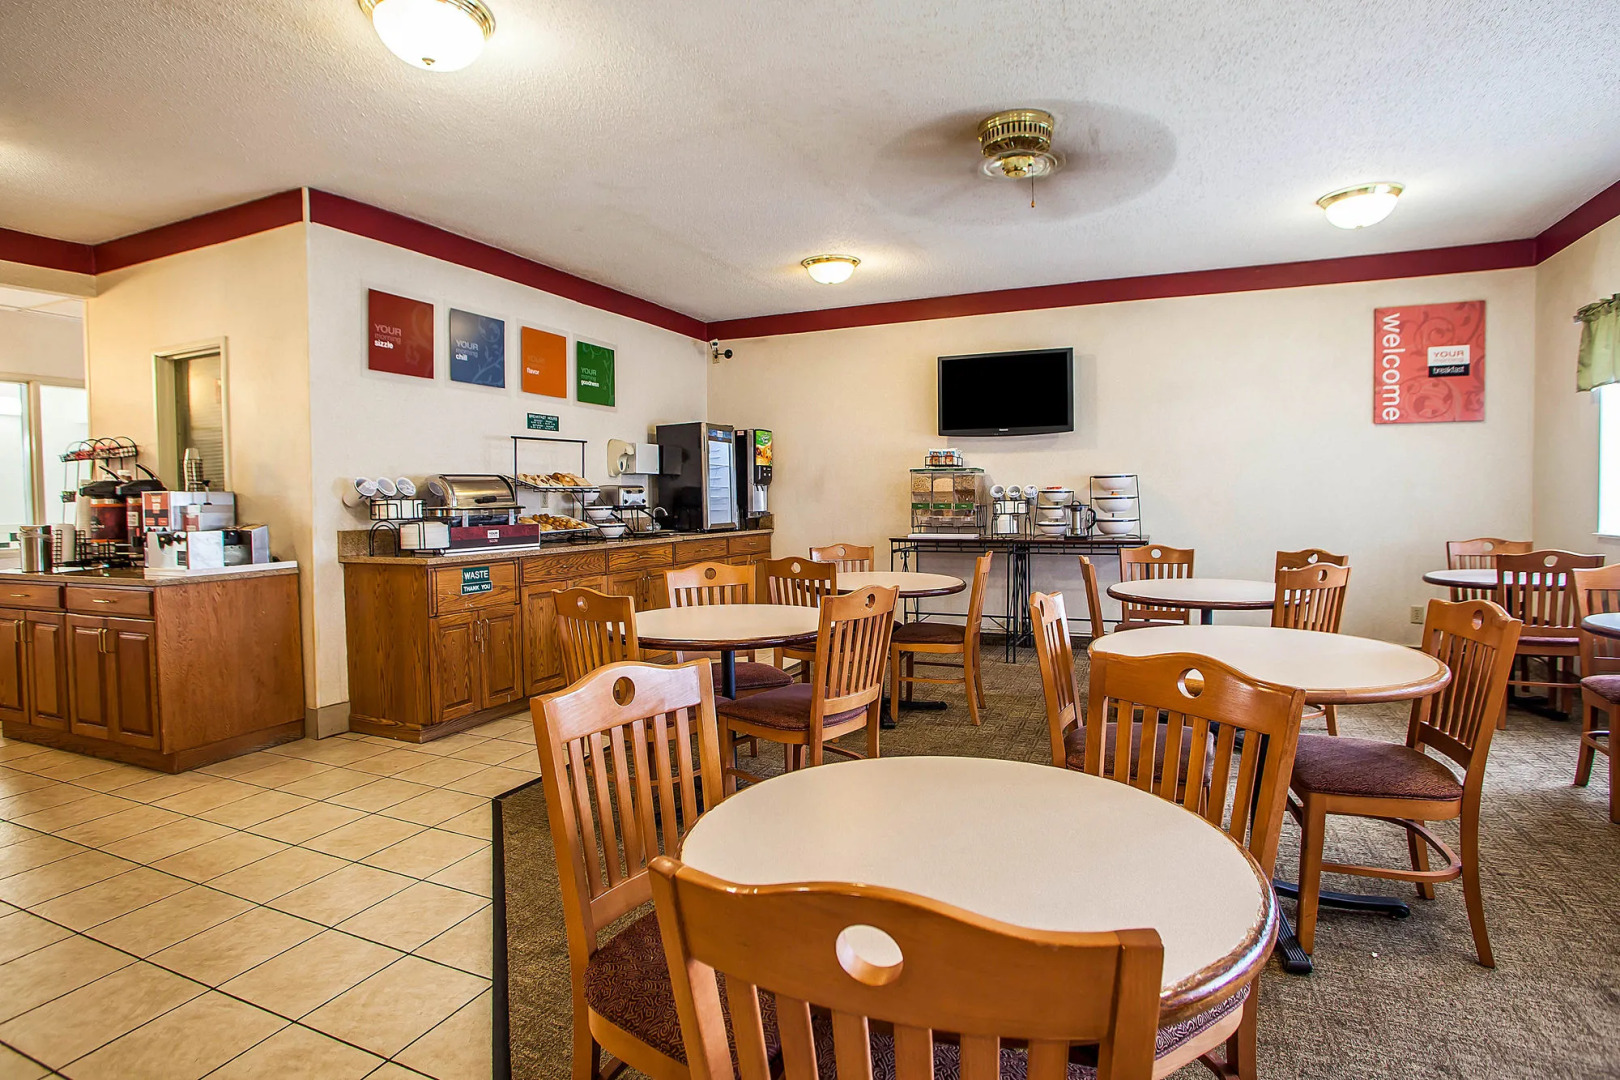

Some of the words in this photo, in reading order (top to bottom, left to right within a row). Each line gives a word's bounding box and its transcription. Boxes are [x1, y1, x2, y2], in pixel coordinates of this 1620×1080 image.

[374, 323, 402, 337] YOUR
[374, 339, 394, 349] sizzle
[455, 338, 479, 351] YOUR
[455, 353, 468, 361] chill
[1433, 350, 1465, 358] YOUR
[526, 367, 540, 375] flavor
[580, 367, 597, 376] YOUR
[1382, 312, 1406, 421] welcome
[1432, 365, 1465, 375] breakfast
[580, 379, 600, 388] goodness
[463, 569, 490, 580] WASTE
